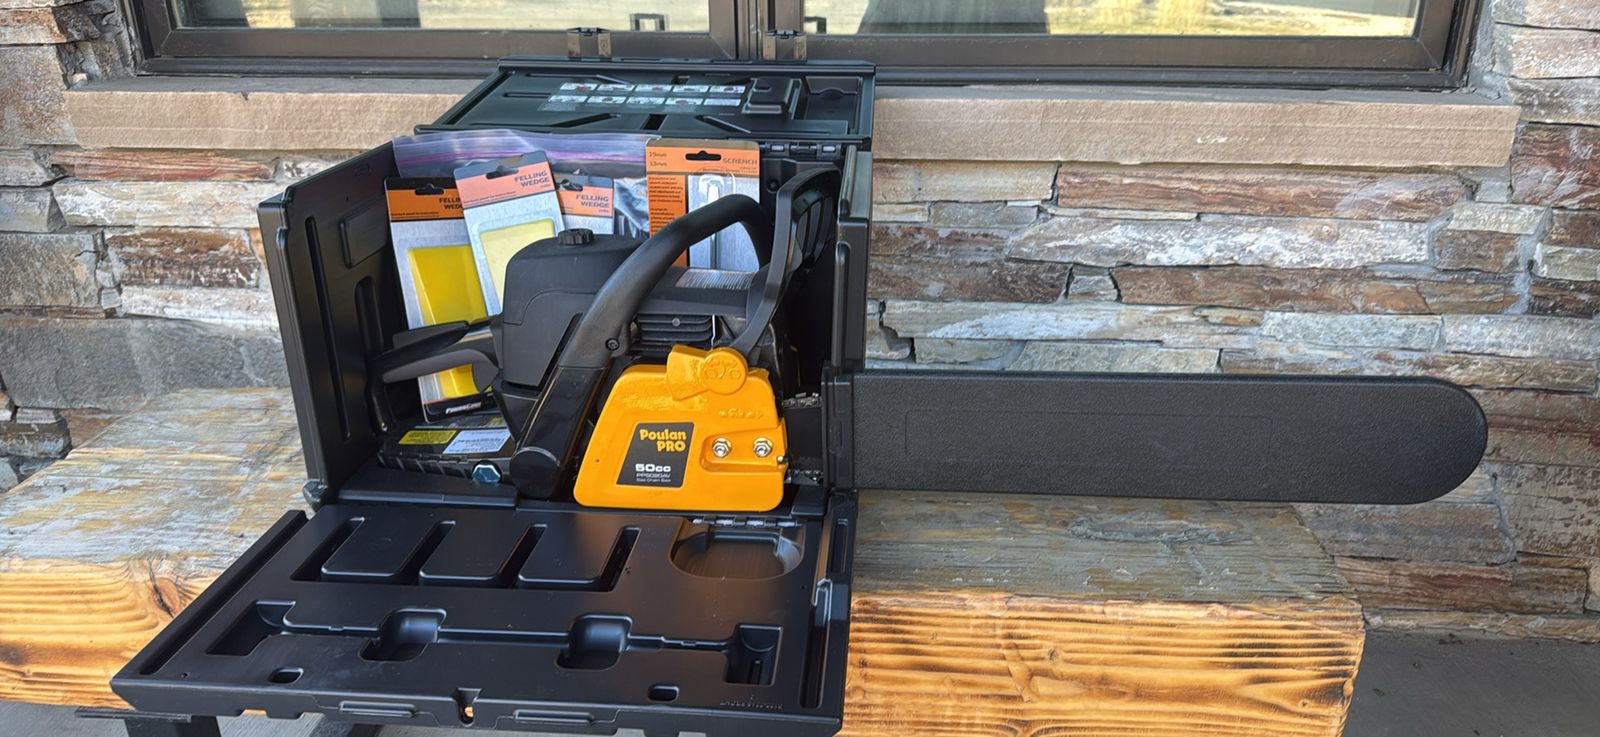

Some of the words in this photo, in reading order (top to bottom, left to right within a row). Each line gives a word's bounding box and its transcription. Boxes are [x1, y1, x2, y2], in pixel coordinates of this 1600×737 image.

[514, 171, 547, 182] FELLING
[520, 178, 550, 188] WEDGE
[576, 194, 609, 202] FELLING
[580, 201, 610, 209] WEDGE
[640, 428, 686, 440] Poulan
[657, 440, 686, 452] PRO
[635, 463, 671, 472] 50cc
